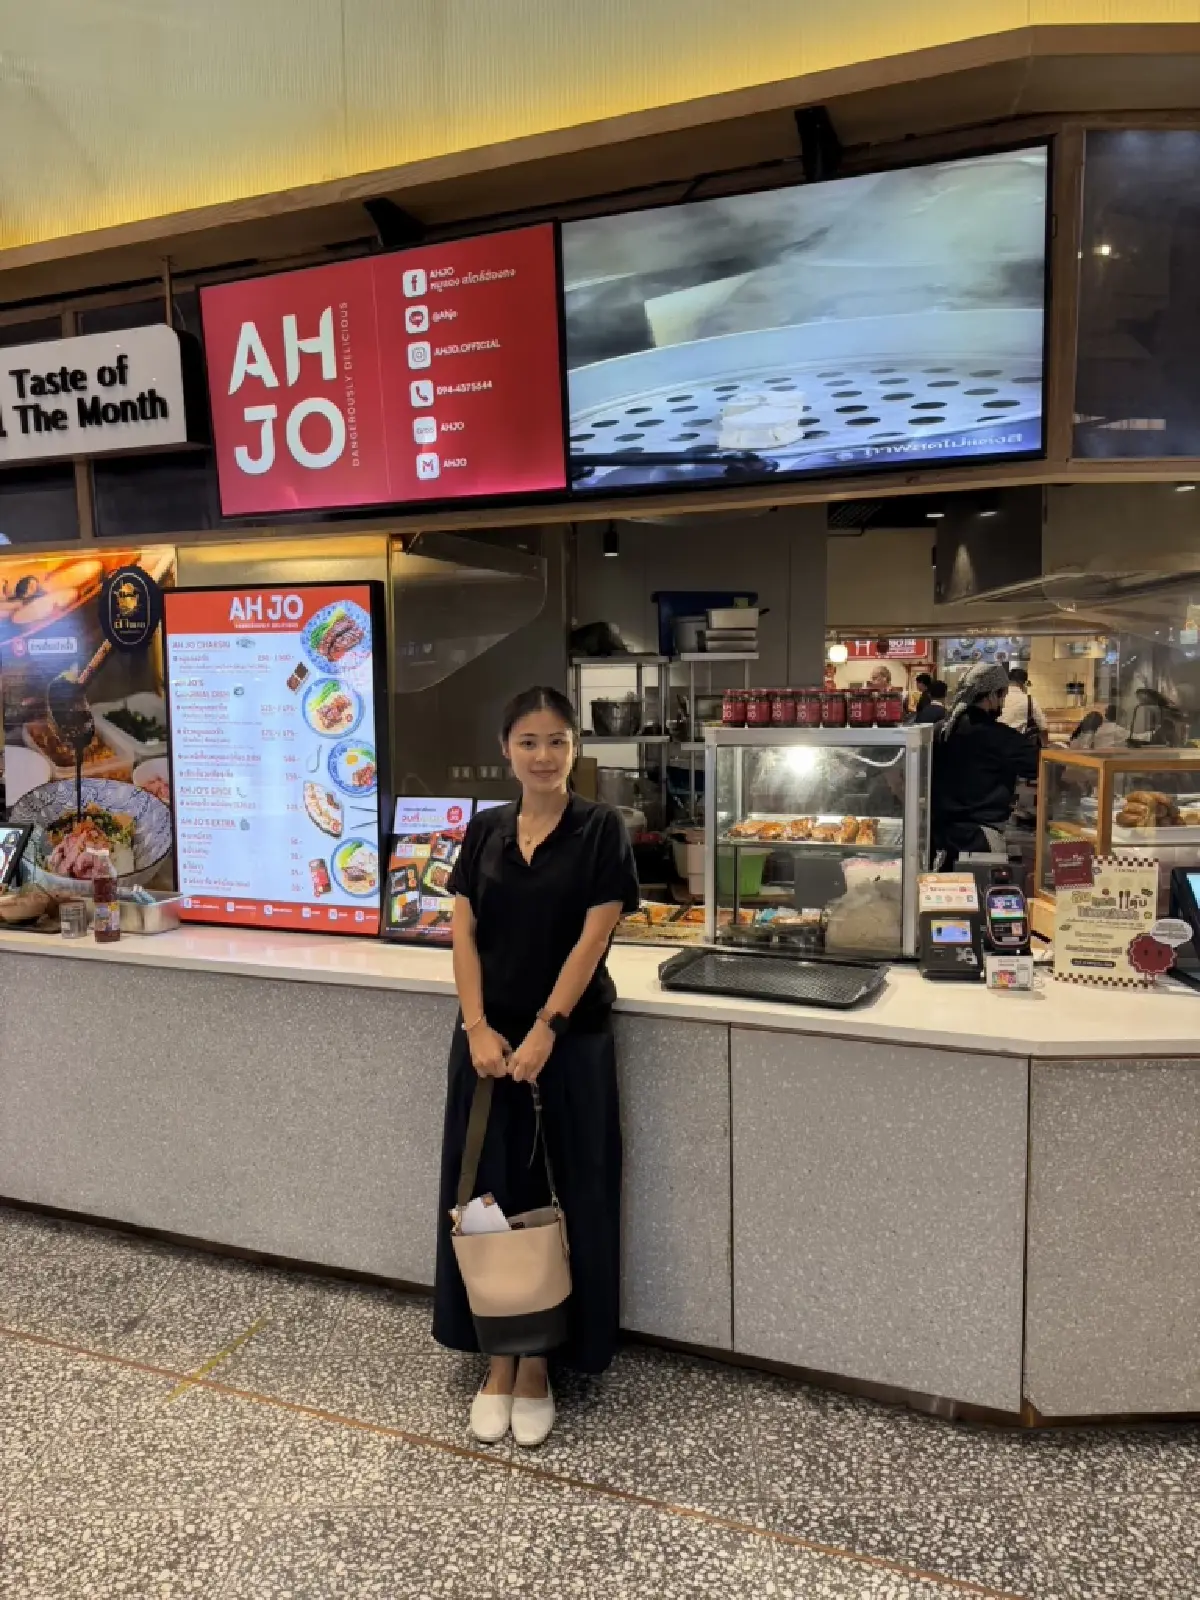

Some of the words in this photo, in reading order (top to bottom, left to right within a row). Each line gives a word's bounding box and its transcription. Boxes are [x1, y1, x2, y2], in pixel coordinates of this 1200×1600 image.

[228, 306, 338, 395] AH
[339, 302, 353, 371] DELICIOUS
[8, 366, 88, 398] Taste
[97, 353, 129, 387] of
[12, 403, 69, 434] The
[77, 388, 169, 428] Month
[234, 397, 346, 475] JO
[345, 375, 360, 467] DANGEROUSLY
[229, 595, 262, 621] AH
[267, 594, 304, 620] JO
